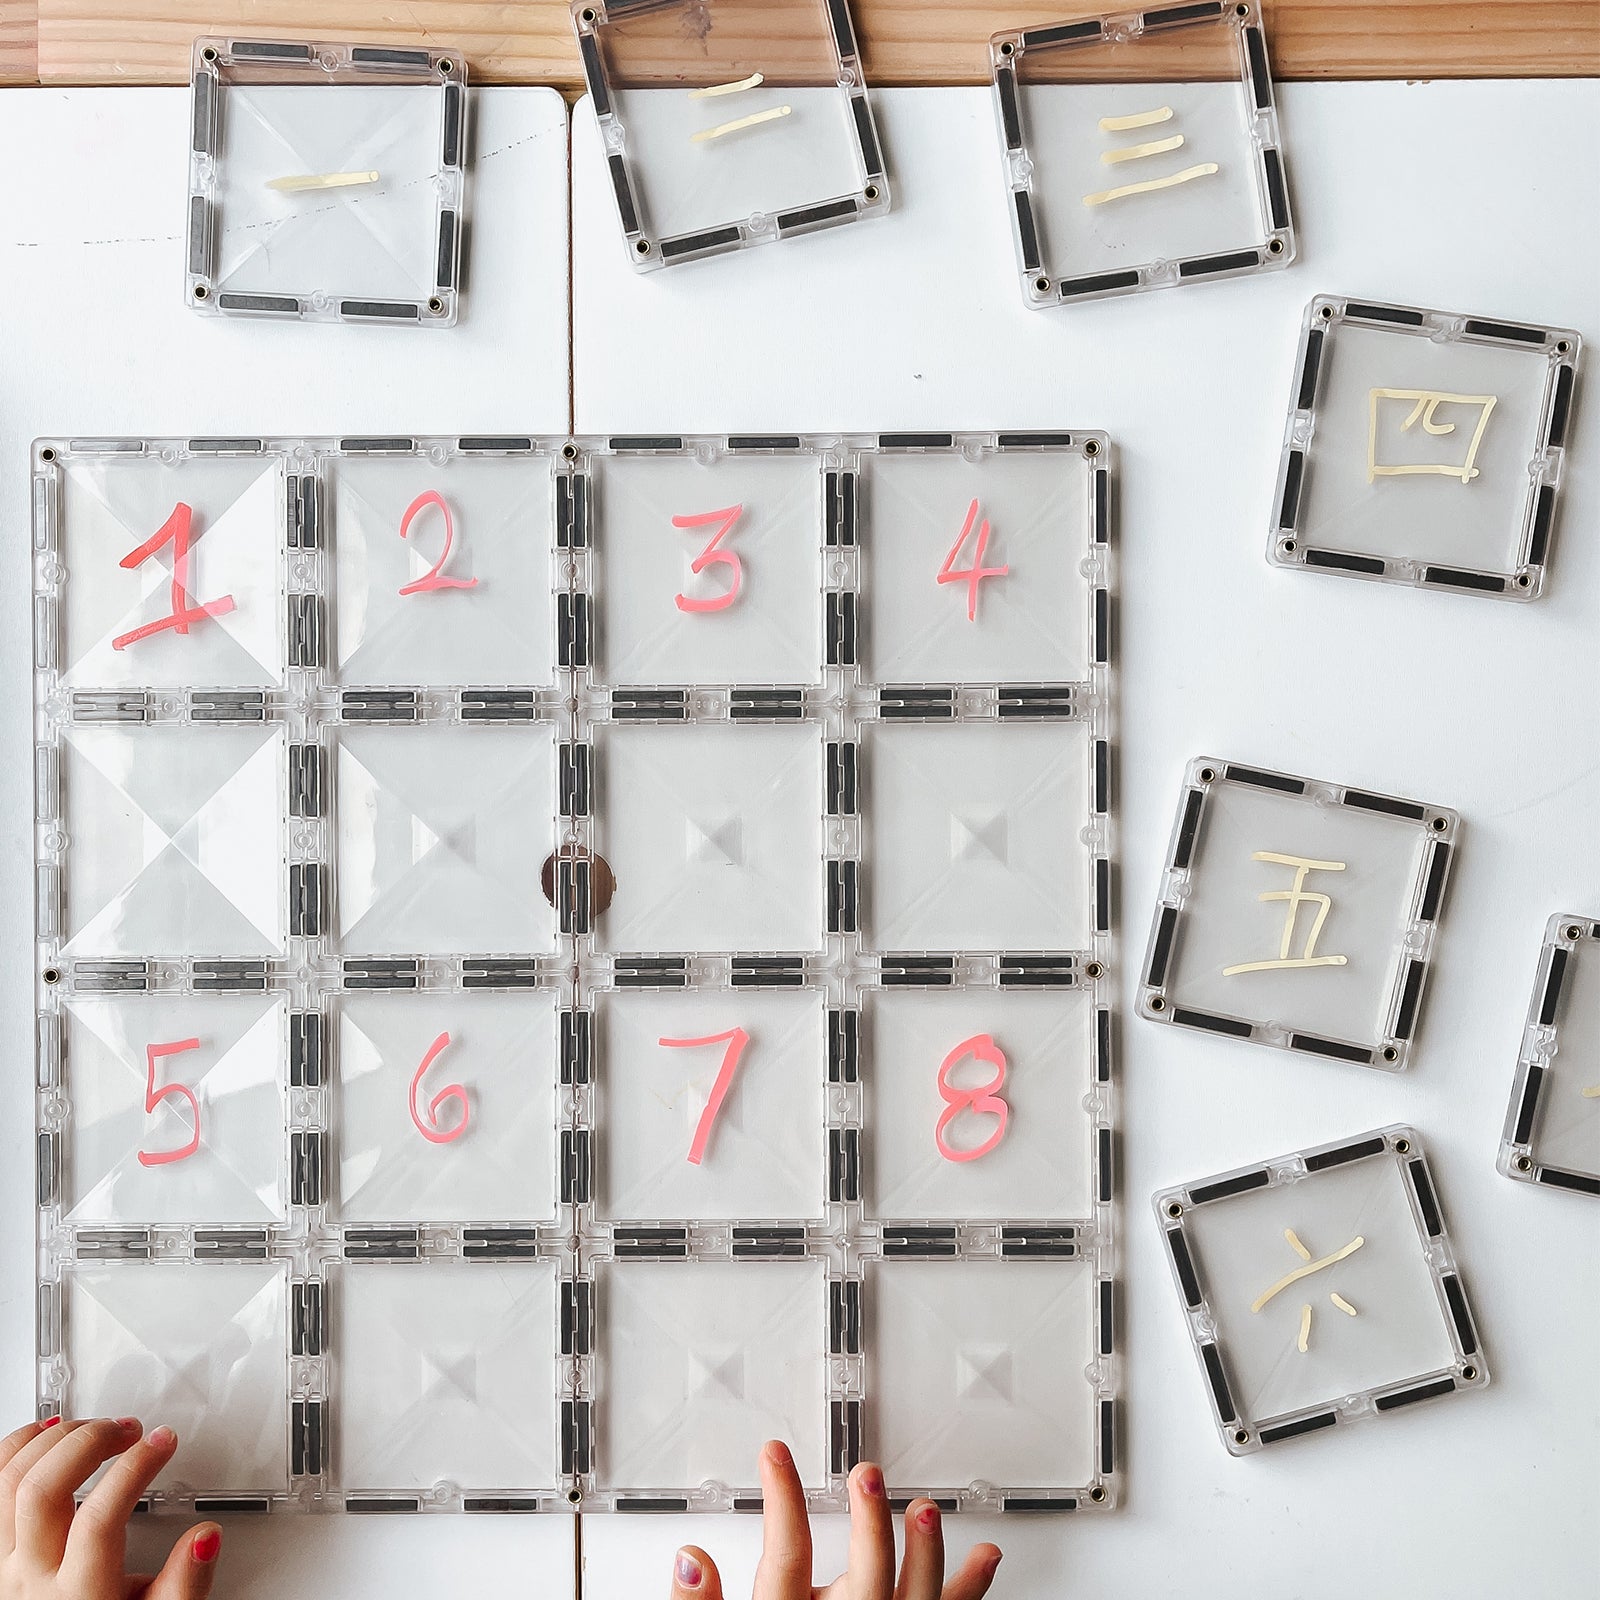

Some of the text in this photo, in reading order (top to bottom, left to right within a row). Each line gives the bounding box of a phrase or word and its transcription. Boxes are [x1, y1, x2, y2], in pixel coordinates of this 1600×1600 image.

[687, 72, 793, 143] 二
[1082, 106, 1219, 206] 三
[1369, 388, 1498, 484] 四
[113, 502, 235, 651] 1
[398, 489, 479, 597] 2
[670, 503, 746, 614] 3
[936, 497, 1010, 623] 4
[1222, 850, 1350, 977] 五
[138, 1037, 202, 1167] 5
[409, 1032, 470, 1144] 6
[658, 1027, 751, 1166] 7
[935, 1033, 1010, 1165] 8
[1251, 1228, 1365, 1353] 六
